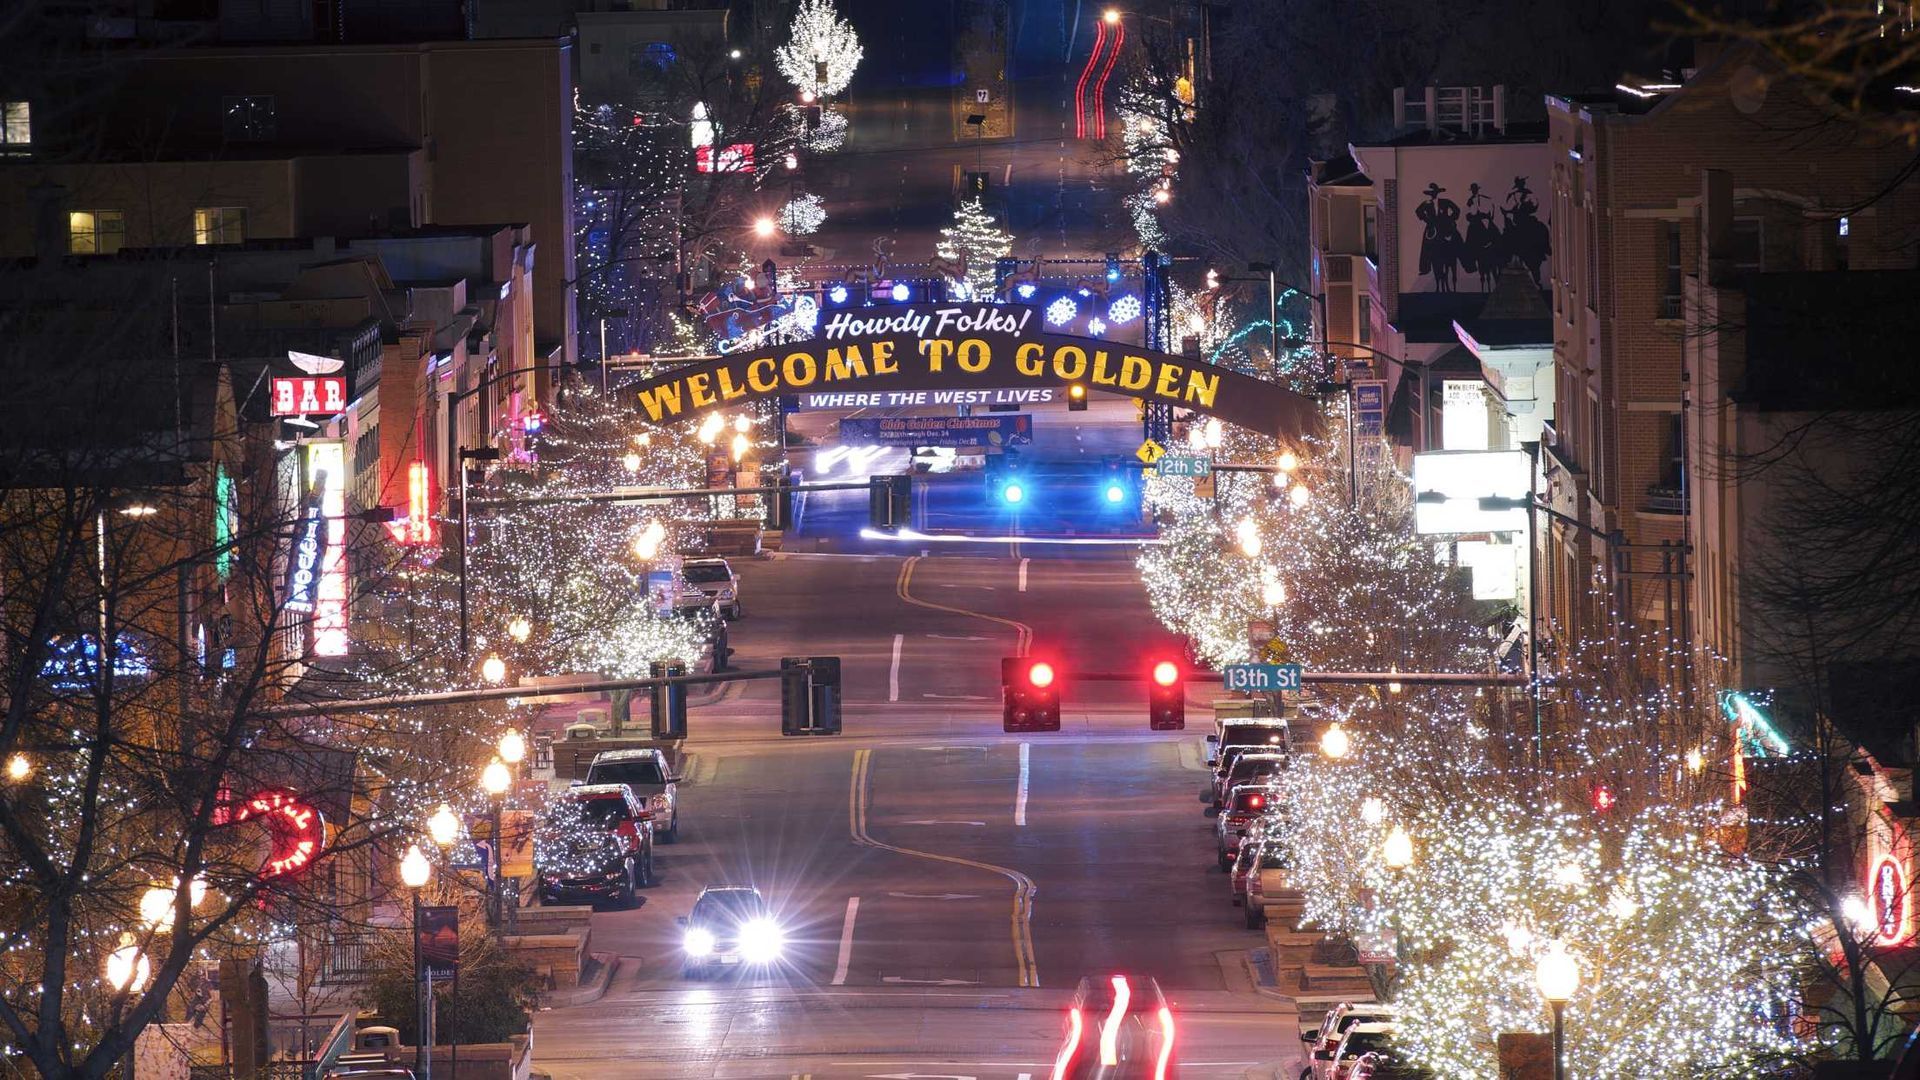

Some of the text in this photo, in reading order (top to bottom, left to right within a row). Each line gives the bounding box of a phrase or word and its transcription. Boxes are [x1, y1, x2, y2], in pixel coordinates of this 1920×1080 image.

[825, 307, 1032, 340] Howdy Folks!
[637, 338, 1221, 421] WELCOME TO GOLDEN
[276, 380, 344, 412] BAR
[809, 389, 1053, 407] WHERE THE WEST LIVES
[907, 418, 945, 430] Golden
[946, 417, 1000, 429] Christmas
[1158, 460, 1209, 474] 12th St
[1227, 668, 1297, 687] 13th St
